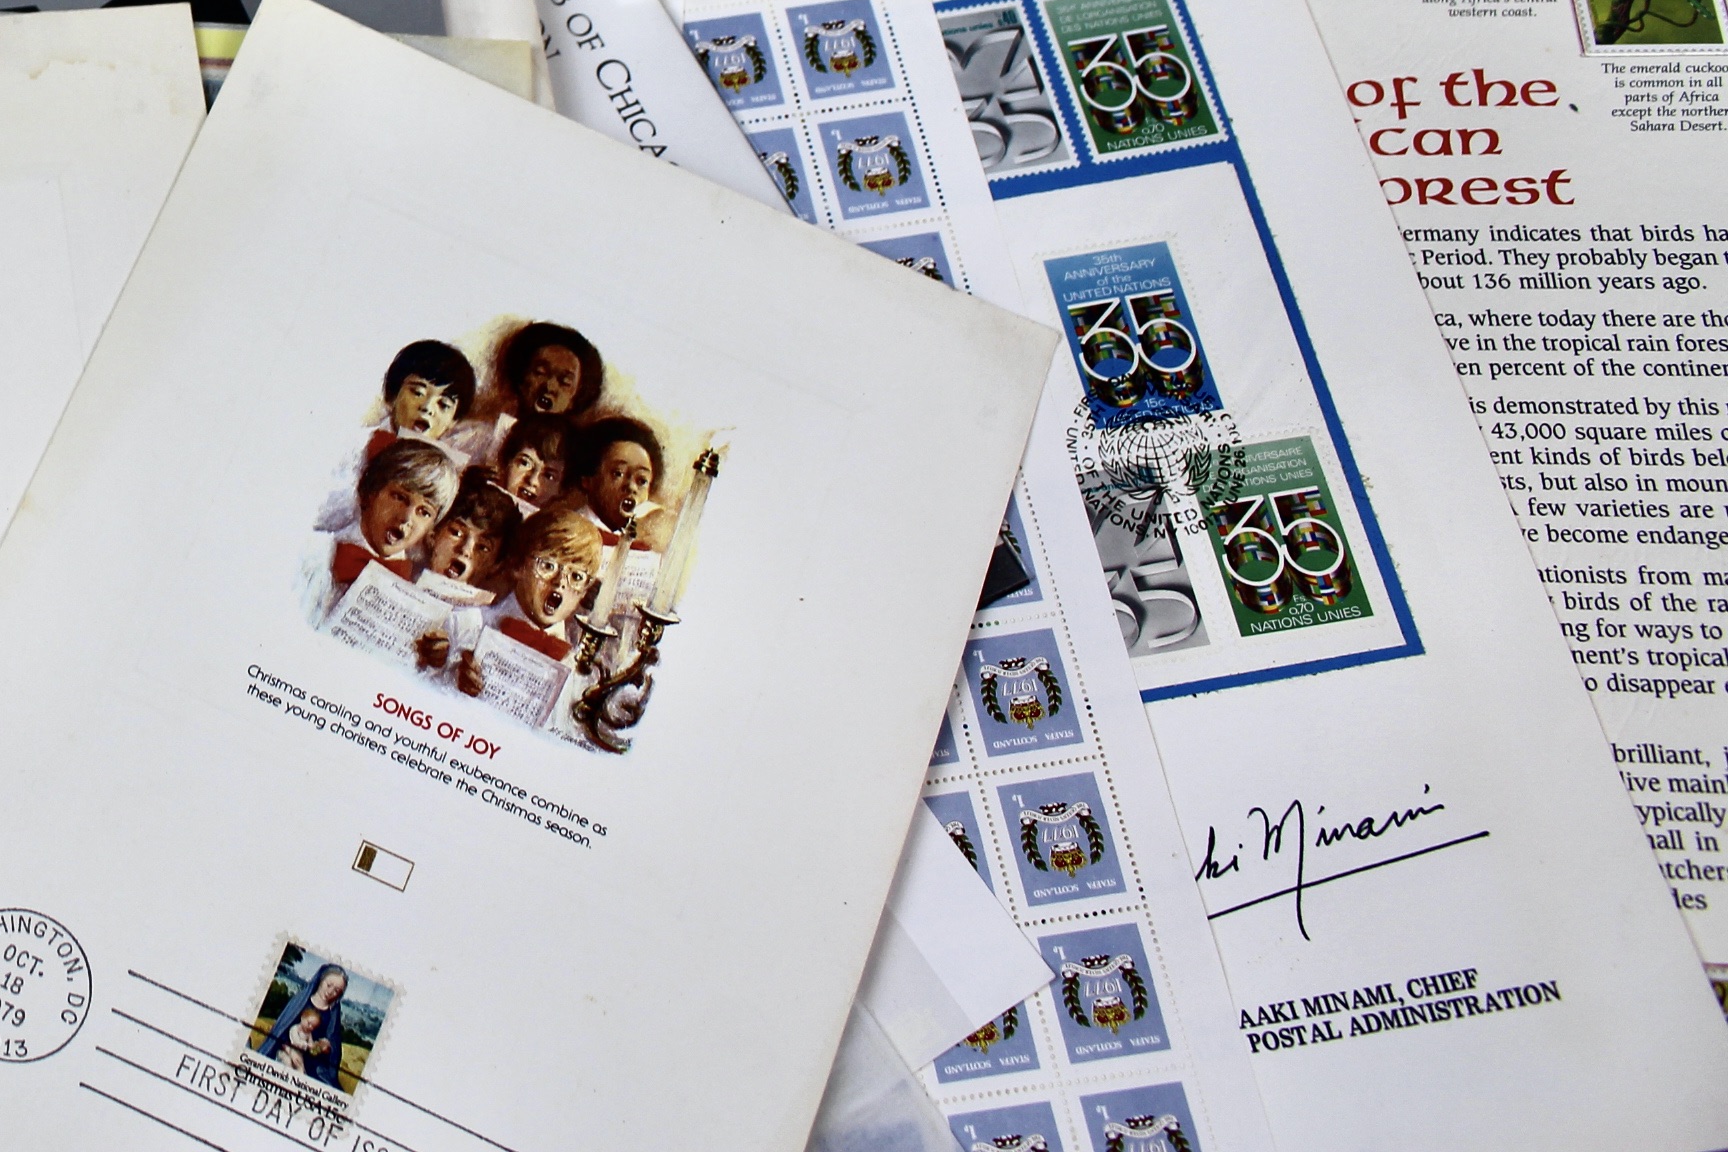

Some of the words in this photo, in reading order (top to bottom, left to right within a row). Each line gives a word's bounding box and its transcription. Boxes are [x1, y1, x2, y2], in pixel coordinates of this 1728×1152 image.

[1446, 6, 1497, 17] western
[1500, 6, 1537, 17] coast.
[1067, 24, 1191, 112] 35
[1600, 61, 1626, 74] The
[1628, 60, 1681, 74] emerald
[1684, 60, 1728, 73] cuckoo
[1613, 78, 1626, 88] is
[1628, 78, 1685, 88] common
[1688, 78, 1703, 88] in
[1705, 75, 1723, 88] all
[566, 13, 604, 53] OF
[596, 58, 672, 162] CHICA
[1346, 76, 1420, 119] of
[1439, 68, 1559, 106] the
[1623, 91, 1658, 106] parts
[1660, 90, 1675, 106] of
[1677, 89, 1720, 106] Africa
[1610, 105, 1652, 121] except
[1656, 104, 1677, 117] the
[1680, 104, 1728, 117] norther
[1629, 119, 1675, 132] Sahara
[1679, 119, 1727, 132] Desert.
[1379, 169, 1574, 205] orest
[1396, 224, 1480, 246] ermany
[1488, 223, 1581, 242] indicates
[1588, 223, 1633, 242] that
[1638, 223, 1695, 242] birds
[1701, 223, 1728, 242] ha
[1061, 285, 1113, 302] UNITED
[1112, 275, 1171, 294] NATIONS
[1415, 270, 1465, 290] bout
[1472, 272, 1511, 290] 136
[1517, 270, 1592, 290] million
[1596, 275, 1656, 294] years
[1661, 275, 1707, 295] ago.
[1066, 288, 1196, 382] 35
[1213, 485, 1344, 587] 35
[1249, 612, 1313, 633] NATIONS
[1315, 604, 1362, 622] UNIES
[372, 693, 432, 730] SONGS
[436, 721, 464, 743] OF
[463, 733, 501, 760] JOY
[245, 682, 282, 708] these
[284, 702, 326, 729] young
[330, 722, 386, 754] choristers
[390, 750, 452, 784] celebrate
[454, 777, 478, 796] the
[481, 788, 541, 825] Christmas
[544, 820, 591, 848] season.
[247, 664, 306, 700] Christmas
[310, 695, 361, 727] caroling
[363, 719, 393, 738] and
[393, 732, 447, 763] youthful
[449, 758, 527, 799] exuberance
[530, 795, 588, 827] combine
[591, 822, 608, 837] as
[1032, 883, 1080, 898] SCOTLAND
[1085, 877, 1117, 890] STAFFA
[3, 944, 44, 977] OCT.
[0, 971, 25, 996] 18
[1239, 1000, 1299, 1029] AAKI
[1300, 982, 1404, 1017] MINAMI,
[1406, 968, 1477, 998] CHIEF
[61, 992, 85, 1025] DC
[1246, 1020, 1342, 1053] POSTAL
[1349, 980, 1561, 1036] ADMINISTRATION
